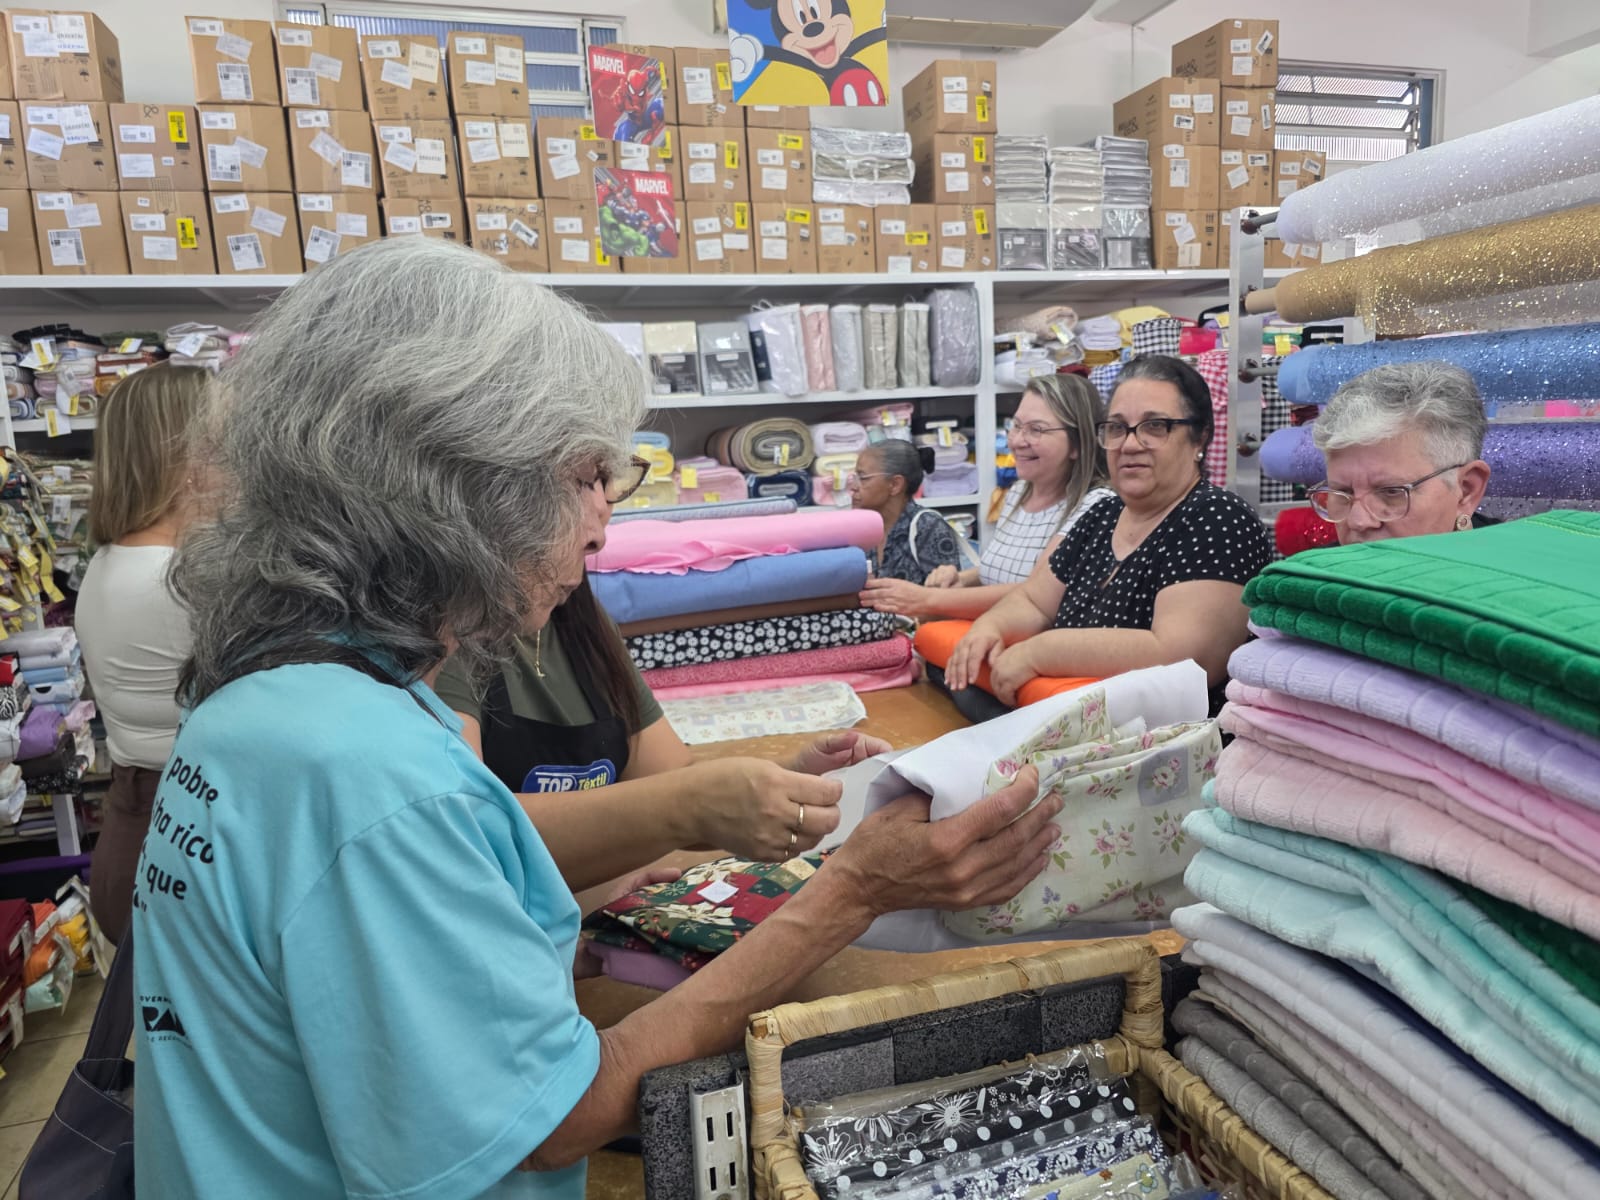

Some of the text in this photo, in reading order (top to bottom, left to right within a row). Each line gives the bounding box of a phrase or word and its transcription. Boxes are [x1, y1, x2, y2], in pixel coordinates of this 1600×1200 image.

[592, 53, 626, 75] MARVEL
[634, 177, 669, 195] MARVEL
[166, 756, 219, 809] pobre
[537, 777, 573, 793] TOP
[153, 796, 172, 836] ha
[170, 823, 215, 864] rico
[146, 863, 187, 900] que
